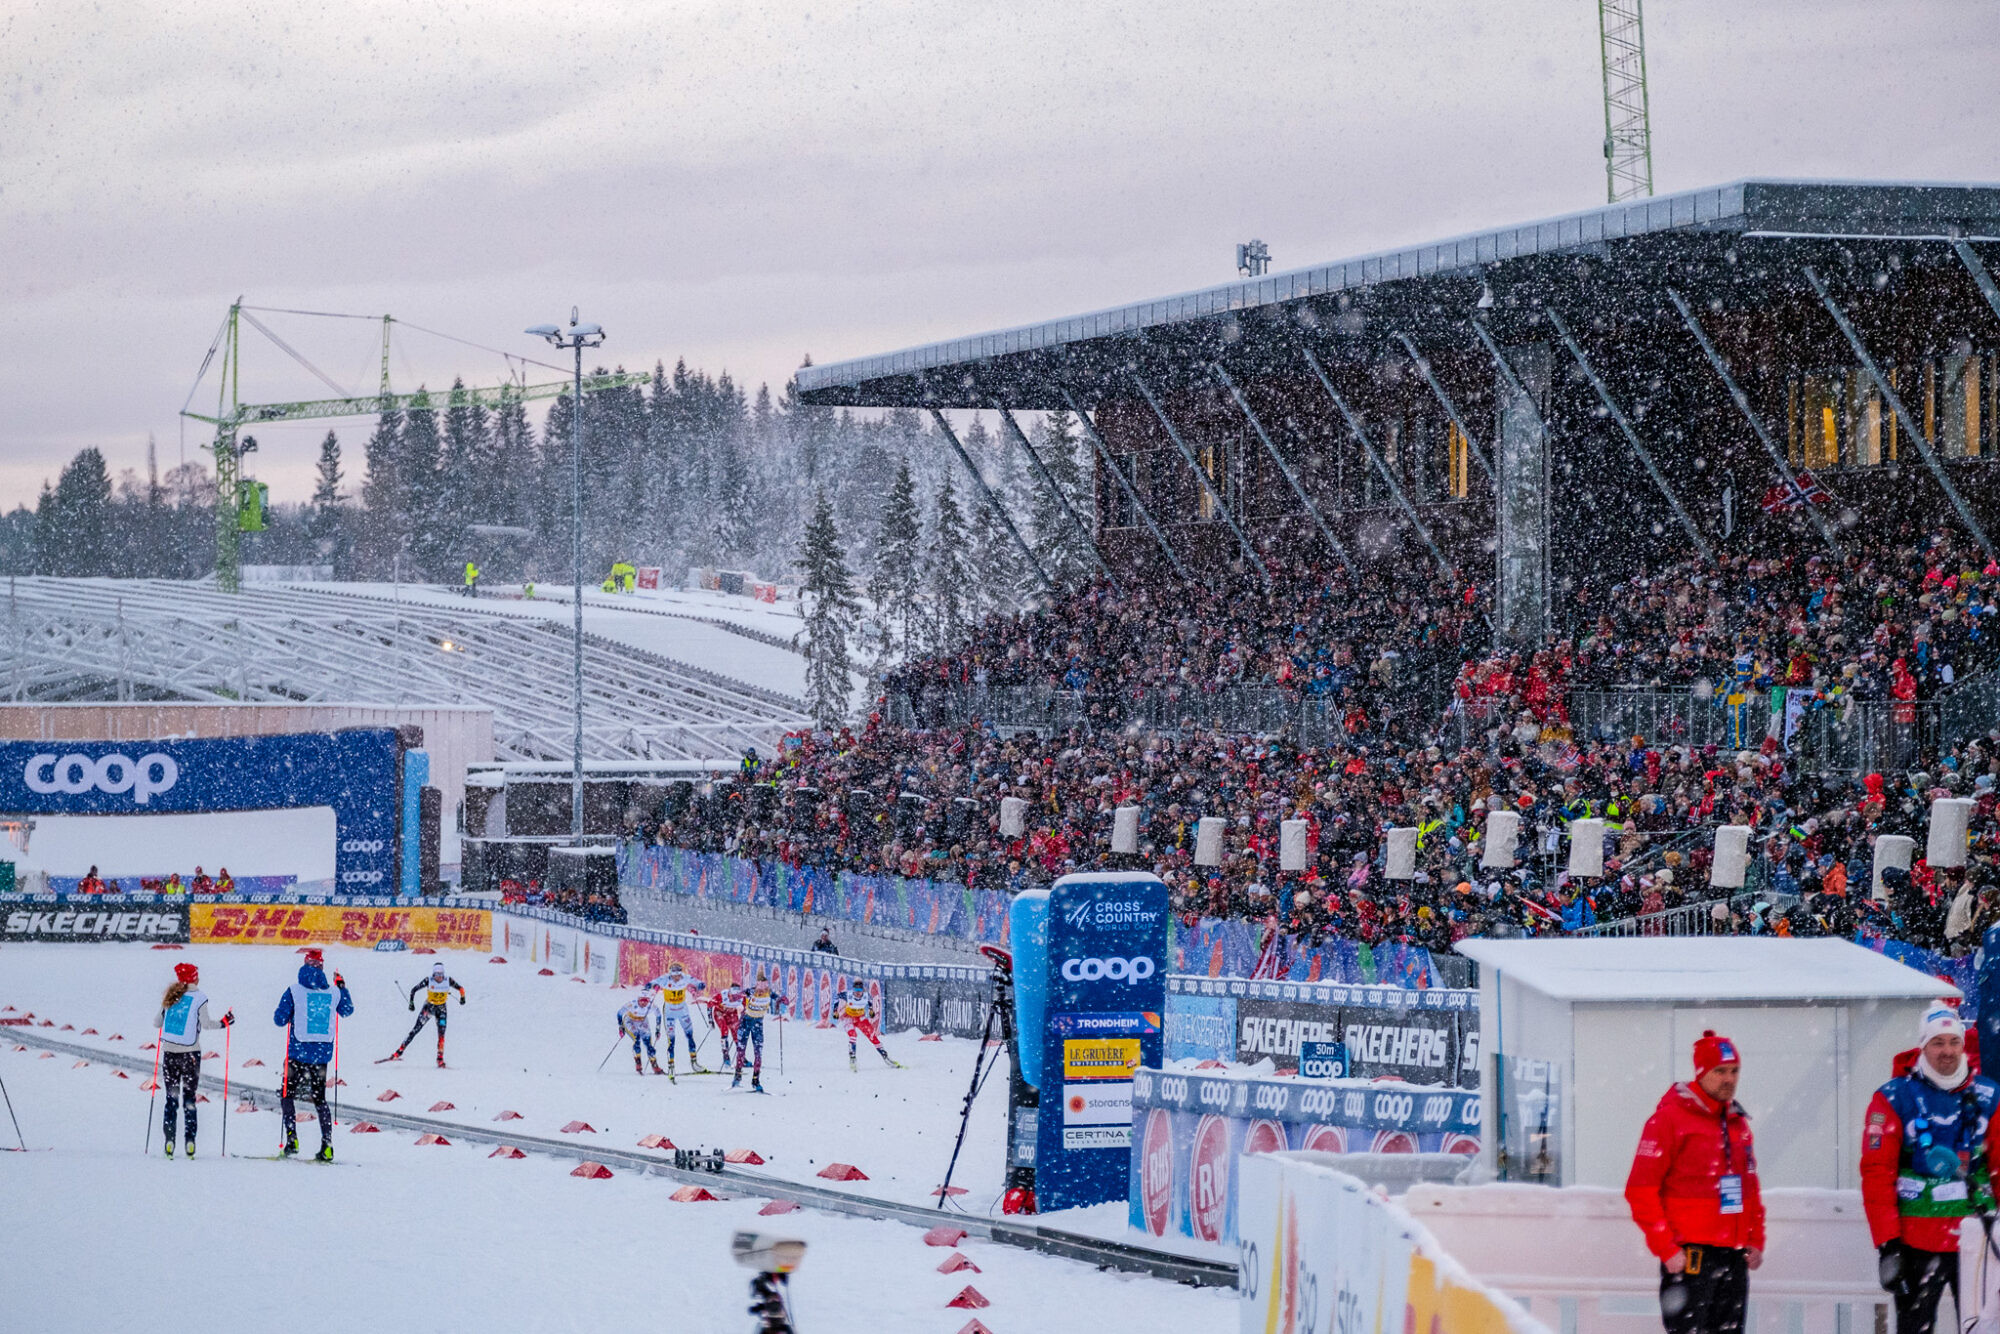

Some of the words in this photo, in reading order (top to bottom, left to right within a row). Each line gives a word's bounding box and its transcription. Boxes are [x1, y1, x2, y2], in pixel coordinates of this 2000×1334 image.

[24, 753, 178, 803] coop
[343, 839, 383, 854] coop
[343, 870, 383, 884] coop
[67, 893, 93, 903] coop
[101, 893, 126, 903] coop
[163, 893, 184, 903] coop
[193, 894, 216, 903] coop
[222, 894, 243, 904] coop
[306, 895, 326, 905] coop
[1095, 901, 1141, 912] CROSS
[4, 911, 182, 935] SKECHERS
[210, 908, 311, 940] DHL
[1095, 911, 1157, 923] COUNTRY
[341, 911, 413, 943] DHL
[1134, 922, 1154, 931] CUP
[1062, 956, 1155, 985] coop
[1078, 1018, 1139, 1028] TRONDHEIM
[1070, 1048, 1080, 1060] LE
[1316, 1043, 1335, 1055] 50m
[1345, 1025, 1448, 1068] SKECHERS
[1305, 1060, 1343, 1079] coop
[1135, 1074, 1153, 1103] coop
[1161, 1077, 1188, 1108] coop
[1200, 1080, 1230, 1112] coop
[1256, 1084, 1289, 1117] coop
[1300, 1088, 1336, 1121] coop
[1344, 1092, 1365, 1124] coop
[1375, 1093, 1413, 1127] coop
[1423, 1096, 1452, 1128] coop
[1065, 1130, 1125, 1139] CERTINA
[1018, 1144, 1035, 1164] coop
